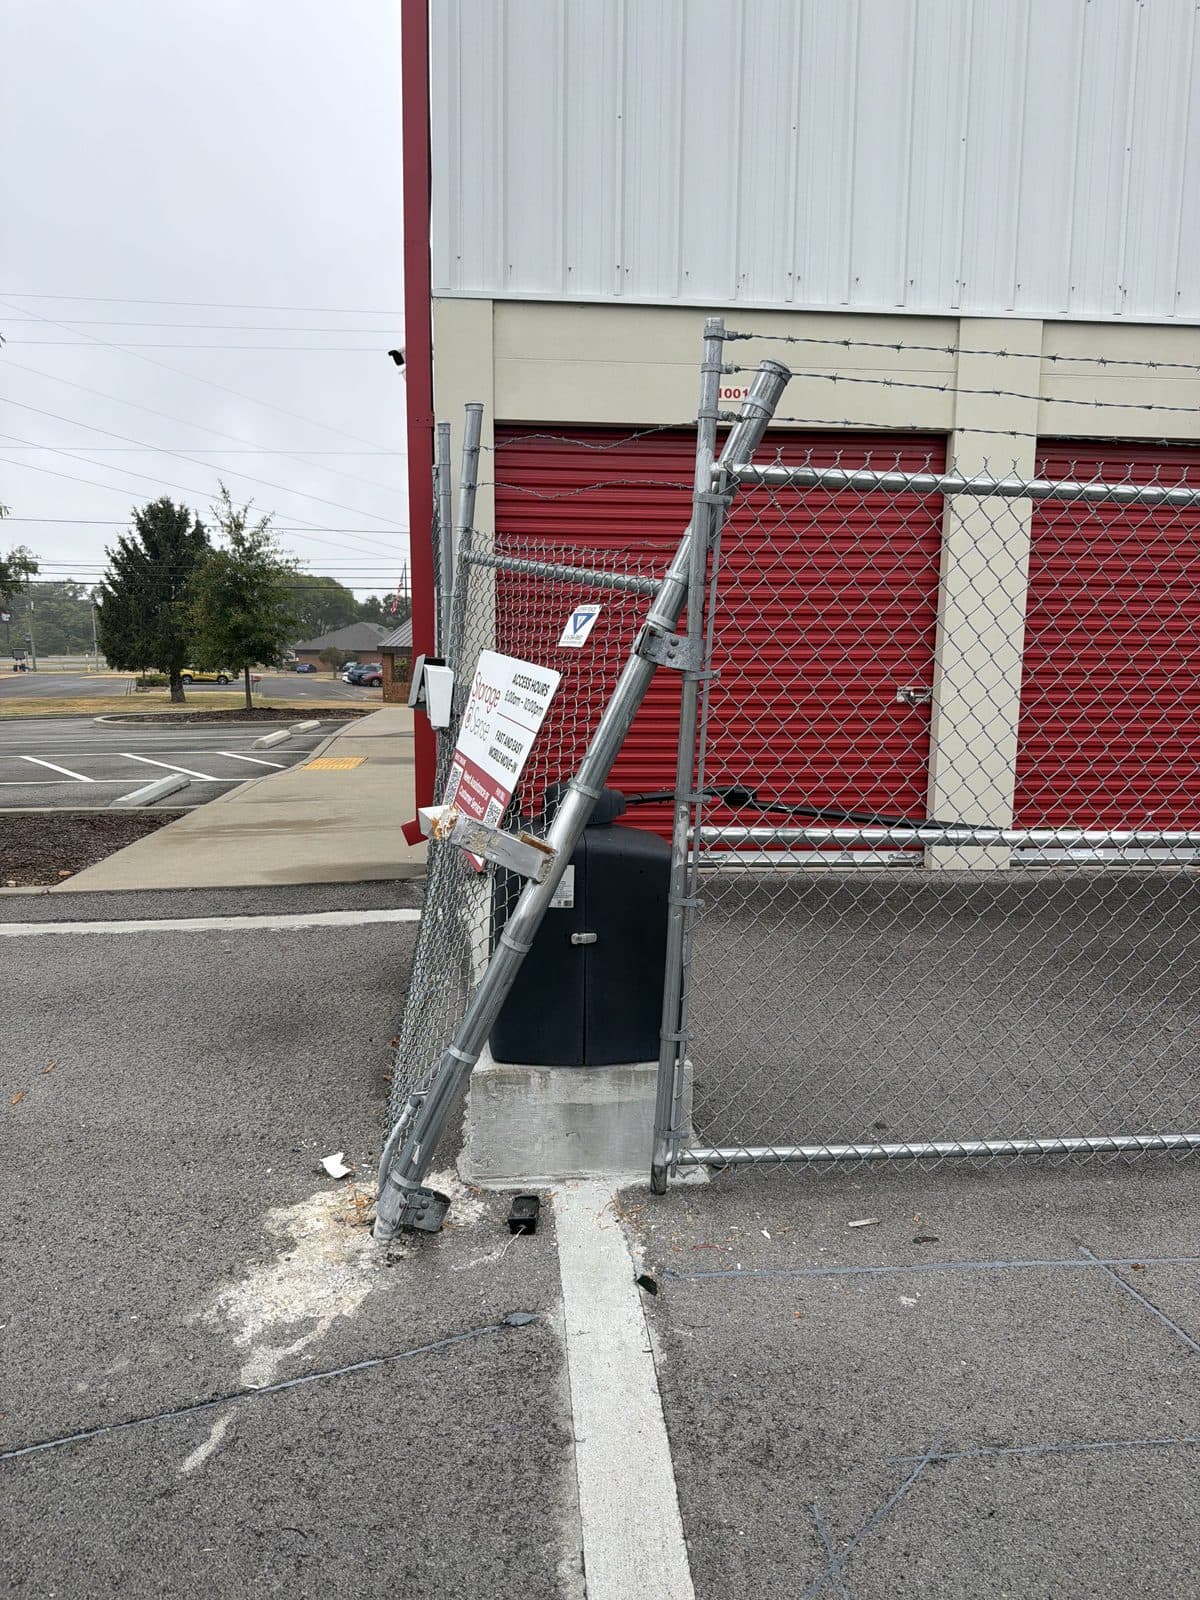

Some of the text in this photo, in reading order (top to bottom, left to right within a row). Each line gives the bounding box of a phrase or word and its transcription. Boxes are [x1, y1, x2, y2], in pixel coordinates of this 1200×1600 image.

[718, 387, 749, 399] 1001
[472, 671, 501, 714] Storage
[512, 673, 550, 697] ACCESS HOURS
[469, 706, 491, 742] Sense
[495, 729, 523, 756] FAST AND EASY
[488, 745, 504, 763] MOBILE
[500, 753, 518, 774] MOVE-IN
